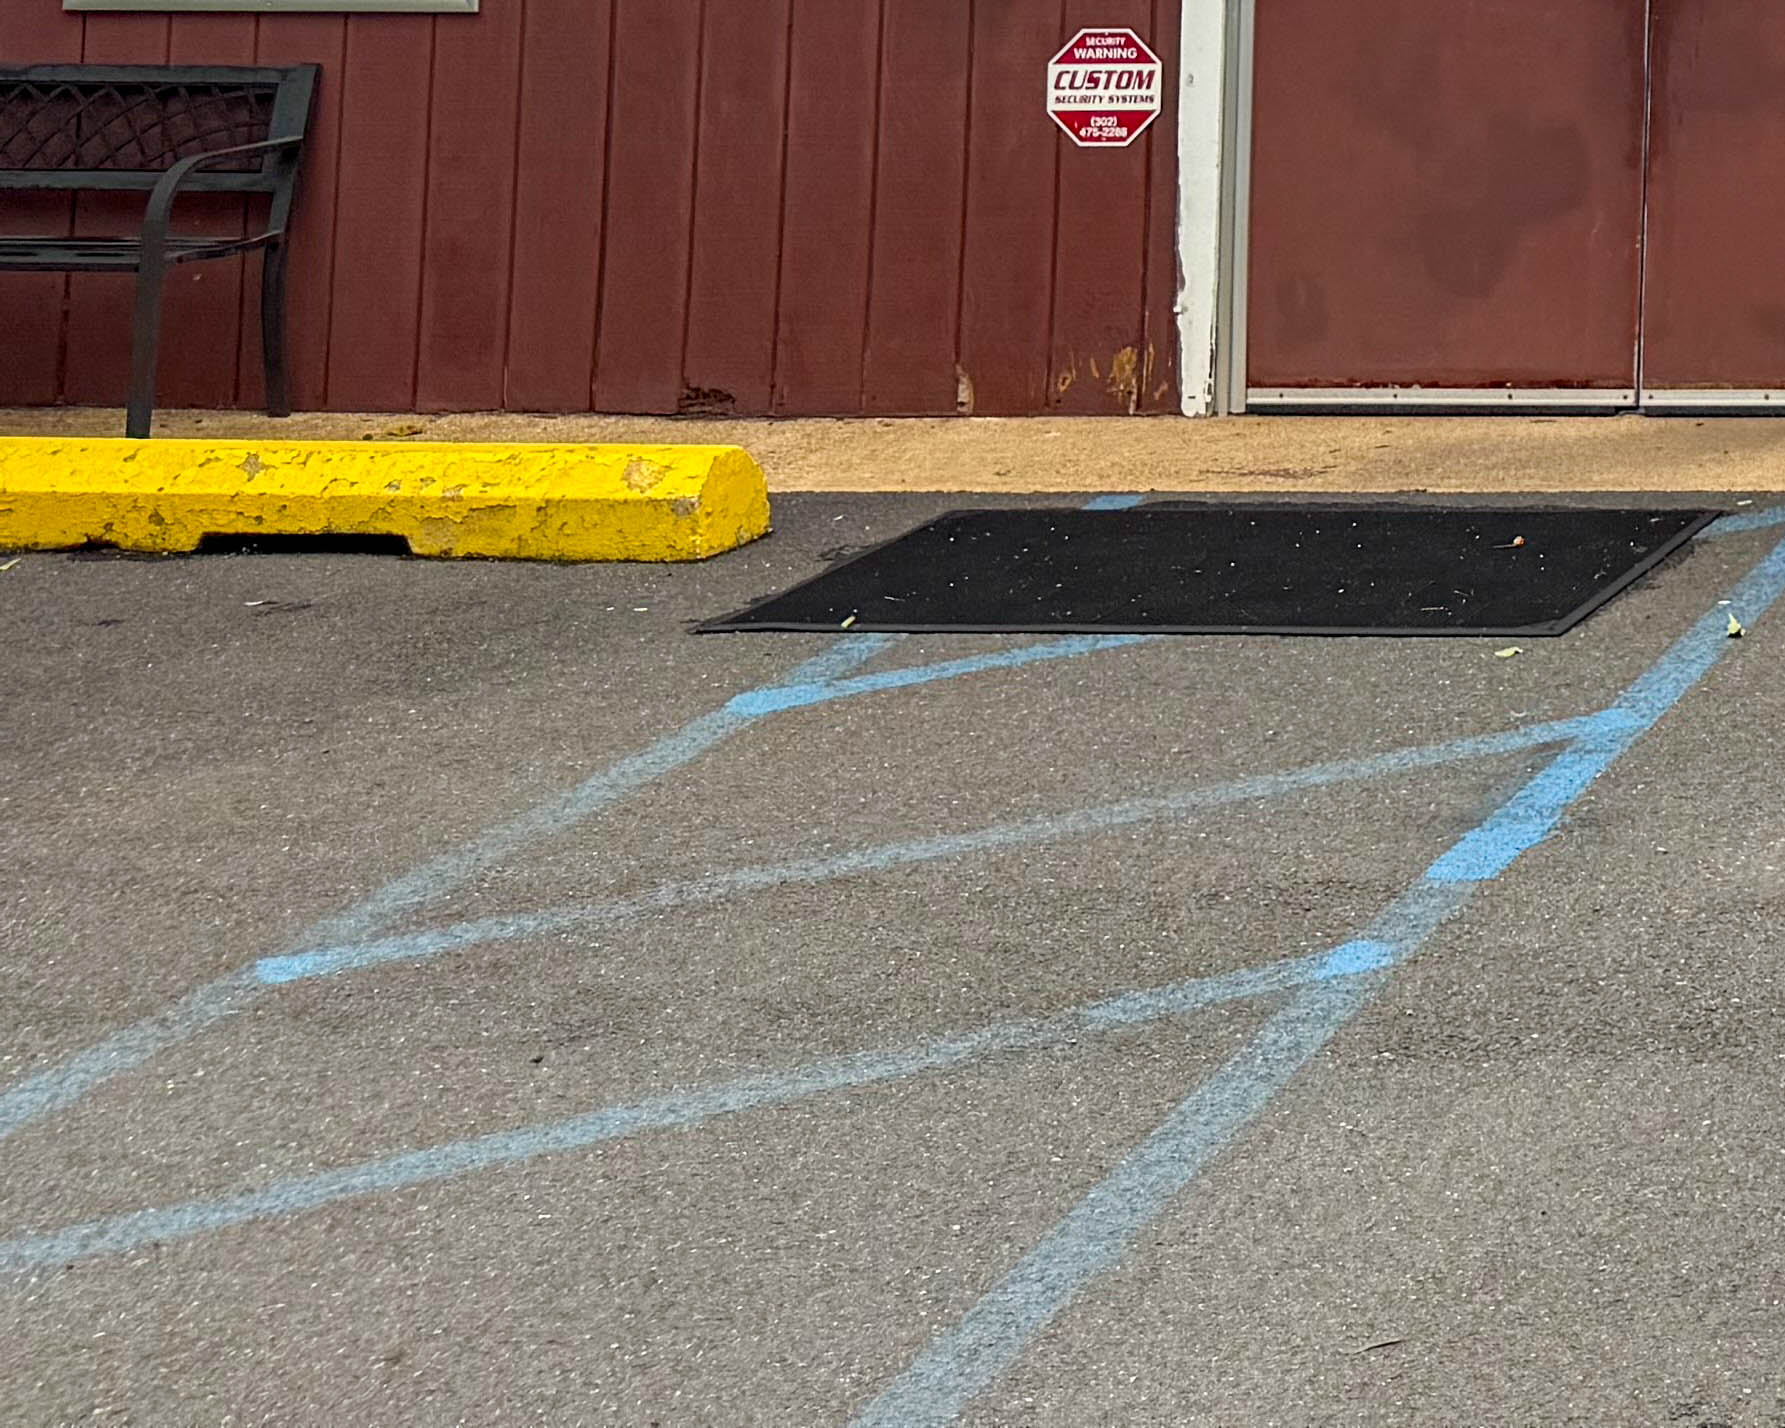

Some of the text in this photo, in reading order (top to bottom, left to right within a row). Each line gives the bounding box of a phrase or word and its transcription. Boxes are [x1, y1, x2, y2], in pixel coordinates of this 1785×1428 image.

[1085, 37, 1126, 46] SECURITY
[1073, 48, 1138, 59] WARNING
[1054, 70, 1156, 90] CUSTOM
[1055, 95, 1155, 104] SECURITY SYSTEMS
[1090, 116, 1117, 127] (302)
